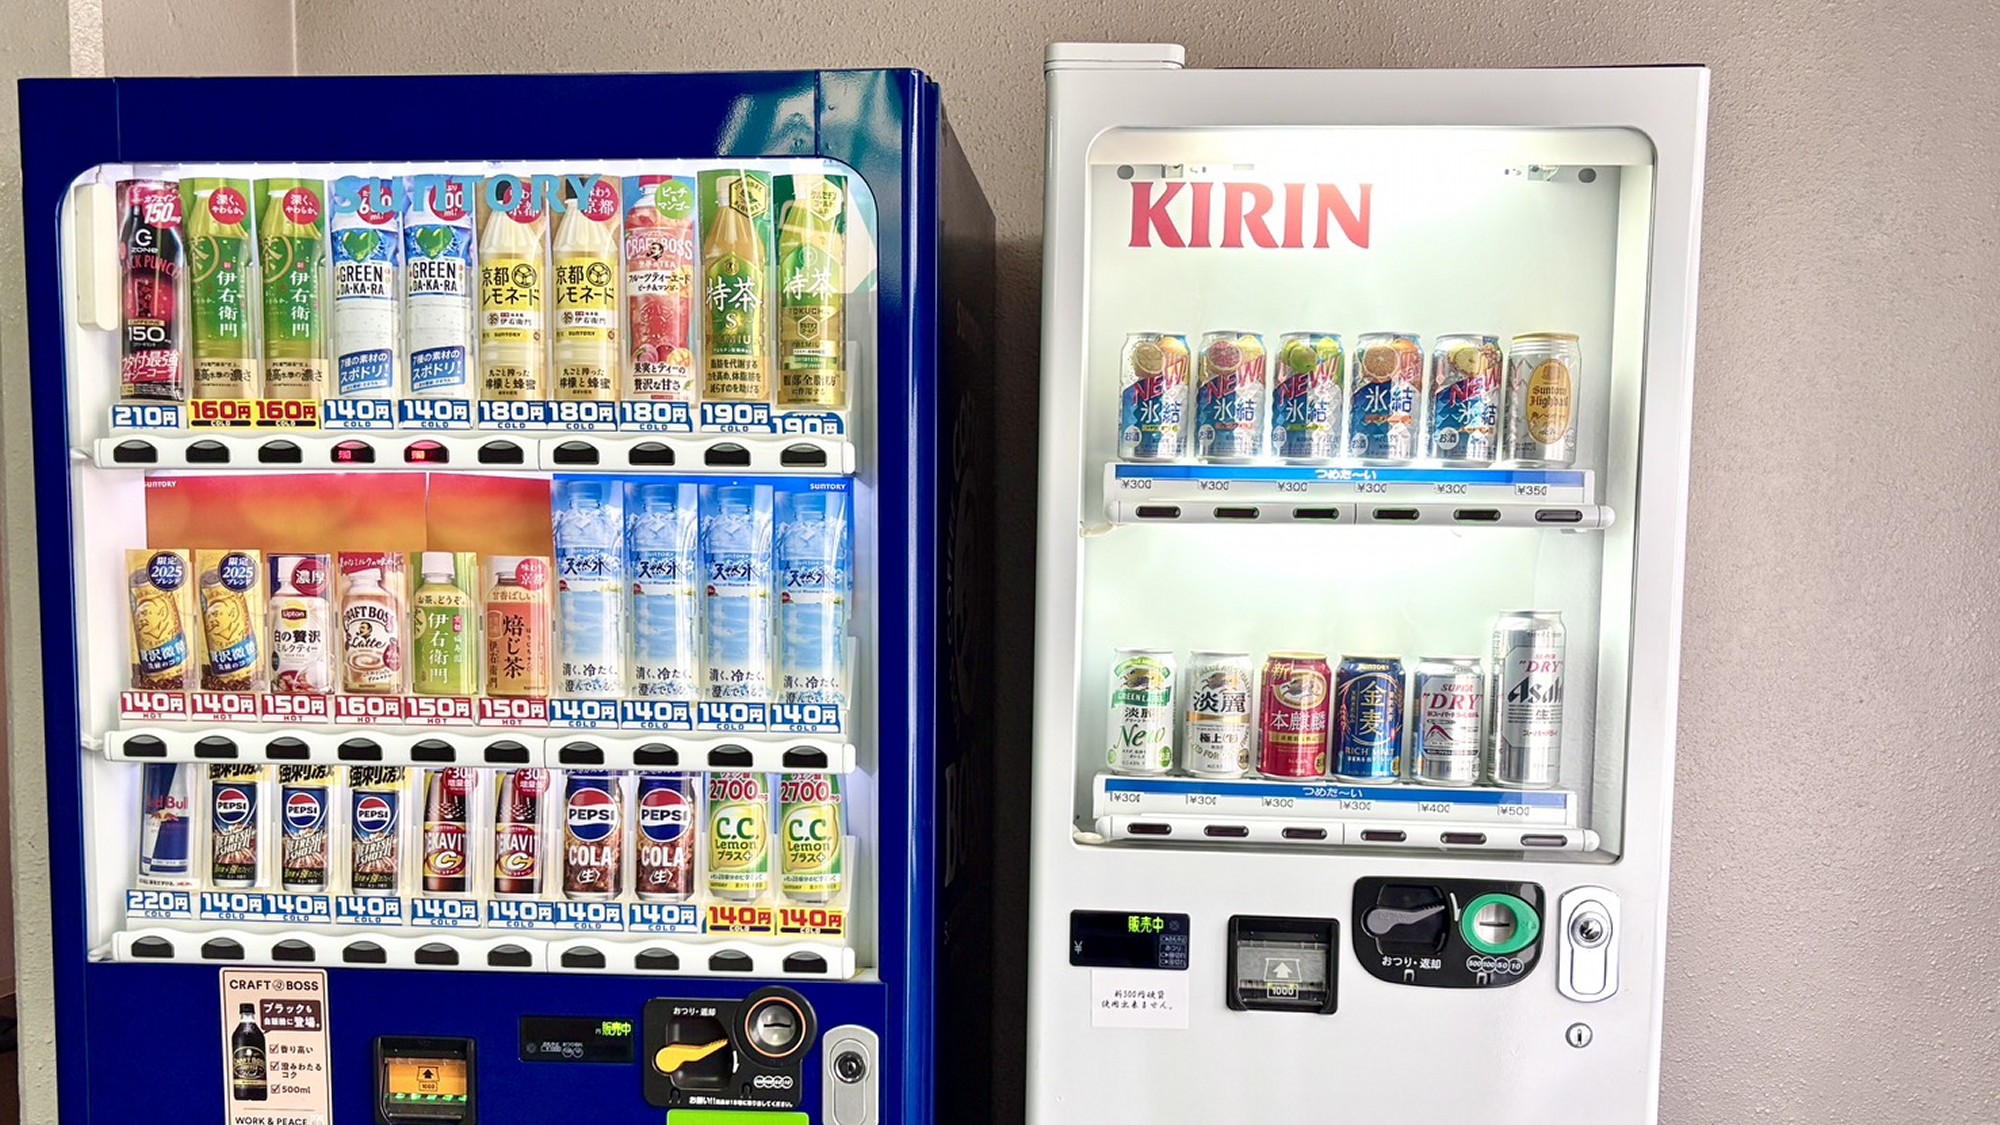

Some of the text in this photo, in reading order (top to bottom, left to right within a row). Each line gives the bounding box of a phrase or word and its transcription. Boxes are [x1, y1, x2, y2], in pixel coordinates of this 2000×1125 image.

[334, 174, 602, 214] SUNTORY
[662, 186, 688, 197] ピーチ
[658, 201, 690, 211] マンゴー
[1128, 181, 1373, 249] KIRIN
[340, 264, 383, 283] GREEN
[413, 260, 456, 279] GREEN
[482, 267, 509, 286] 京都
[556, 266, 583, 285] 京都
[783, 266, 839, 301] 特茶
[482, 286, 540, 306] レモネード
[556, 286, 614, 305] レモネード
[706, 275, 763, 312] 特茶
[217, 270, 239, 338] 伊右衛門
[290, 270, 311, 338] 伊右衛門
[725, 312, 738, 329] S
[634, 363, 686, 374] 果実とティーの
[485, 379, 536, 391] 檸檬と蜂蜜
[559, 378, 611, 390] 檸檬と蜂蜜
[633, 379, 681, 391] 贅沢な甘さ
[1364, 386, 1414, 413] 氷結
[115, 406, 175, 426] 210円
[191, 401, 250, 420] 160円
[256, 401, 316, 420] 160円
[326, 400, 389, 420] 140円
[401, 400, 465, 420] 140円
[480, 402, 544, 421] 180円
[548, 402, 613, 421] 180円
[622, 402, 687, 422] 180円
[703, 404, 768, 424] 190円
[1141, 400, 1181, 423] 氷結
[1214, 398, 1257, 422] 氷結
[1286, 399, 1328, 423] 氷結
[1458, 402, 1497, 426] 氷結
[809, 483, 846, 491] SUNTORY
[156, 557, 178, 566] 限定
[227, 557, 249, 566] 限定
[564, 558, 611, 576] 天然水
[639, 561, 685, 580] 天然水
[151, 566, 183, 578] 2025
[222, 566, 254, 578] 2025
[296, 569, 325, 585] 濃厚
[713, 563, 760, 581] 天然水
[788, 570, 835, 588] 天然水
[418, 595, 465, 605] お茶、どうぞ。
[492, 591, 536, 601] 甘香ばしい
[282, 610, 305, 618] Lipton
[274, 629, 321, 643] 白の贅沢
[350, 637, 386, 648] Latte
[277, 643, 318, 652] ミルクティー
[428, 612, 449, 684] 伊右衛門
[502, 614, 525, 679] 焙じ茶
[562, 663, 618, 677] 清く、冷たく、
[636, 666, 692, 680] 清く、冷たく、
[709, 668, 765, 682] 清く、冷たく、
[1272, 662, 1290, 680] 新
[783, 675, 839, 689] 清く、冷たく、
[123, 694, 182, 712] 140円
[193, 694, 253, 713] 140円
[265, 695, 324, 714] 150円
[337, 698, 399, 716] 160円
[406, 699, 471, 717] 150円
[480, 700, 545, 718] 150円
[551, 701, 616, 720] 140円
[623, 701, 688, 721] 140円
[1193, 691, 1246, 713] 淡麗
[1360, 680, 1387, 736] 金麦
[700, 703, 763, 722] 140円
[772, 704, 837, 724] 140円
[1270, 710, 1326, 731] 本麒麟
[1345, 746, 1369, 755] RICH
[218, 802, 247, 810] PEPSI
[288, 806, 318, 814] PEPSI
[359, 810, 389, 819] PEPSI
[568, 809, 615, 820] PEPSI
[641, 809, 688, 820] PEPSI
[716, 817, 759, 840] C.C.
[715, 839, 757, 850] Lemon
[788, 841, 830, 852] Lemon
[568, 845, 613, 867] COLA
[641, 845, 686, 867] COLA
[129, 891, 190, 910] 220円
[203, 893, 265, 911] 140円
[267, 895, 328, 913] 140円
[339, 897, 399, 915] 140円
[414, 900, 475, 917] 140円
[490, 902, 551, 920] 140円
[558, 903, 618, 921] 140円
[632, 905, 696, 924] 140円
[709, 907, 771, 925] 140円
[779, 910, 842, 927] 140円
[1128, 915, 1164, 933] 販売中
[1382, 955, 1441, 970] おつり・返却
[229, 979, 318, 991] CRAFT BOSS
[1271, 985, 1294, 997] 1000
[263, 1003, 312, 1014] ブラックも
[602, 1021, 632, 1036] 販売中
[280, 1045, 313, 1054] 香り高い
[280, 1062, 322, 1071] 澄みわたる
[282, 1071, 297, 1079] コク
[282, 1085, 311, 1094] 500ml
[235, 1117, 265, 1125] WORK
[267, 1117, 274, 1125] &
